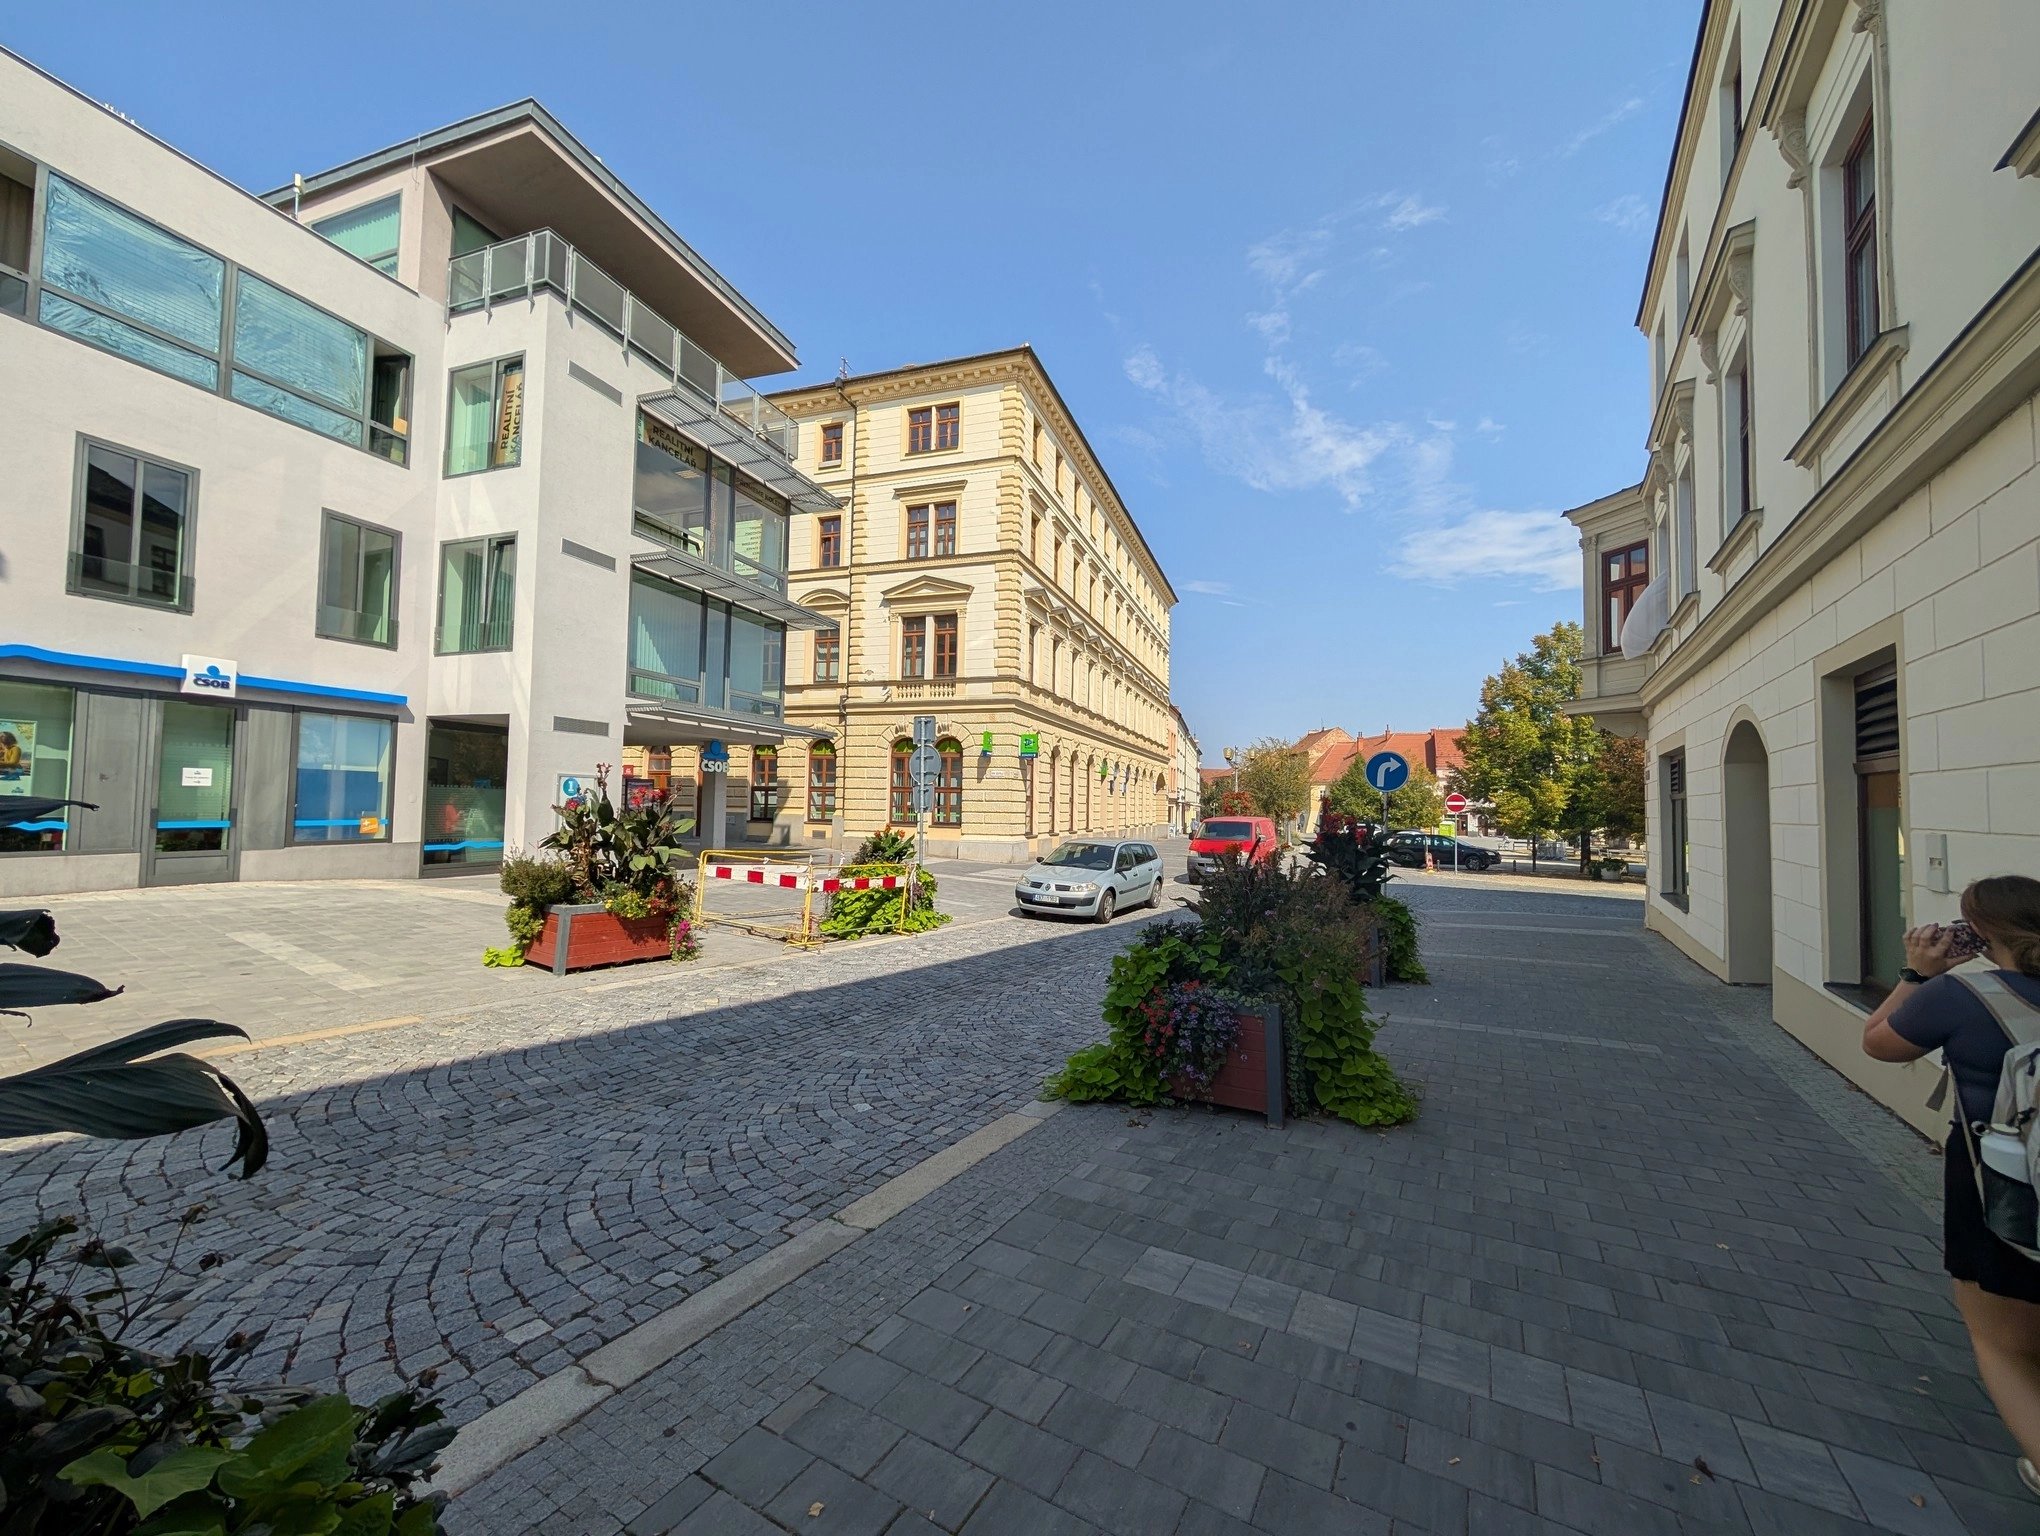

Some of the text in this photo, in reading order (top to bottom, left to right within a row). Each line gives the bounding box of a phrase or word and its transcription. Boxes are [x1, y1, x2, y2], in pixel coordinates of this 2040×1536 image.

[500, 389, 515, 450] REALITNÍ
[648, 435, 697, 469] KANCELÁŘ
[652, 425, 694, 456] REALITNÍ
[193, 676, 231, 689] ČSOB
[700, 758, 729, 773] ČSOB
